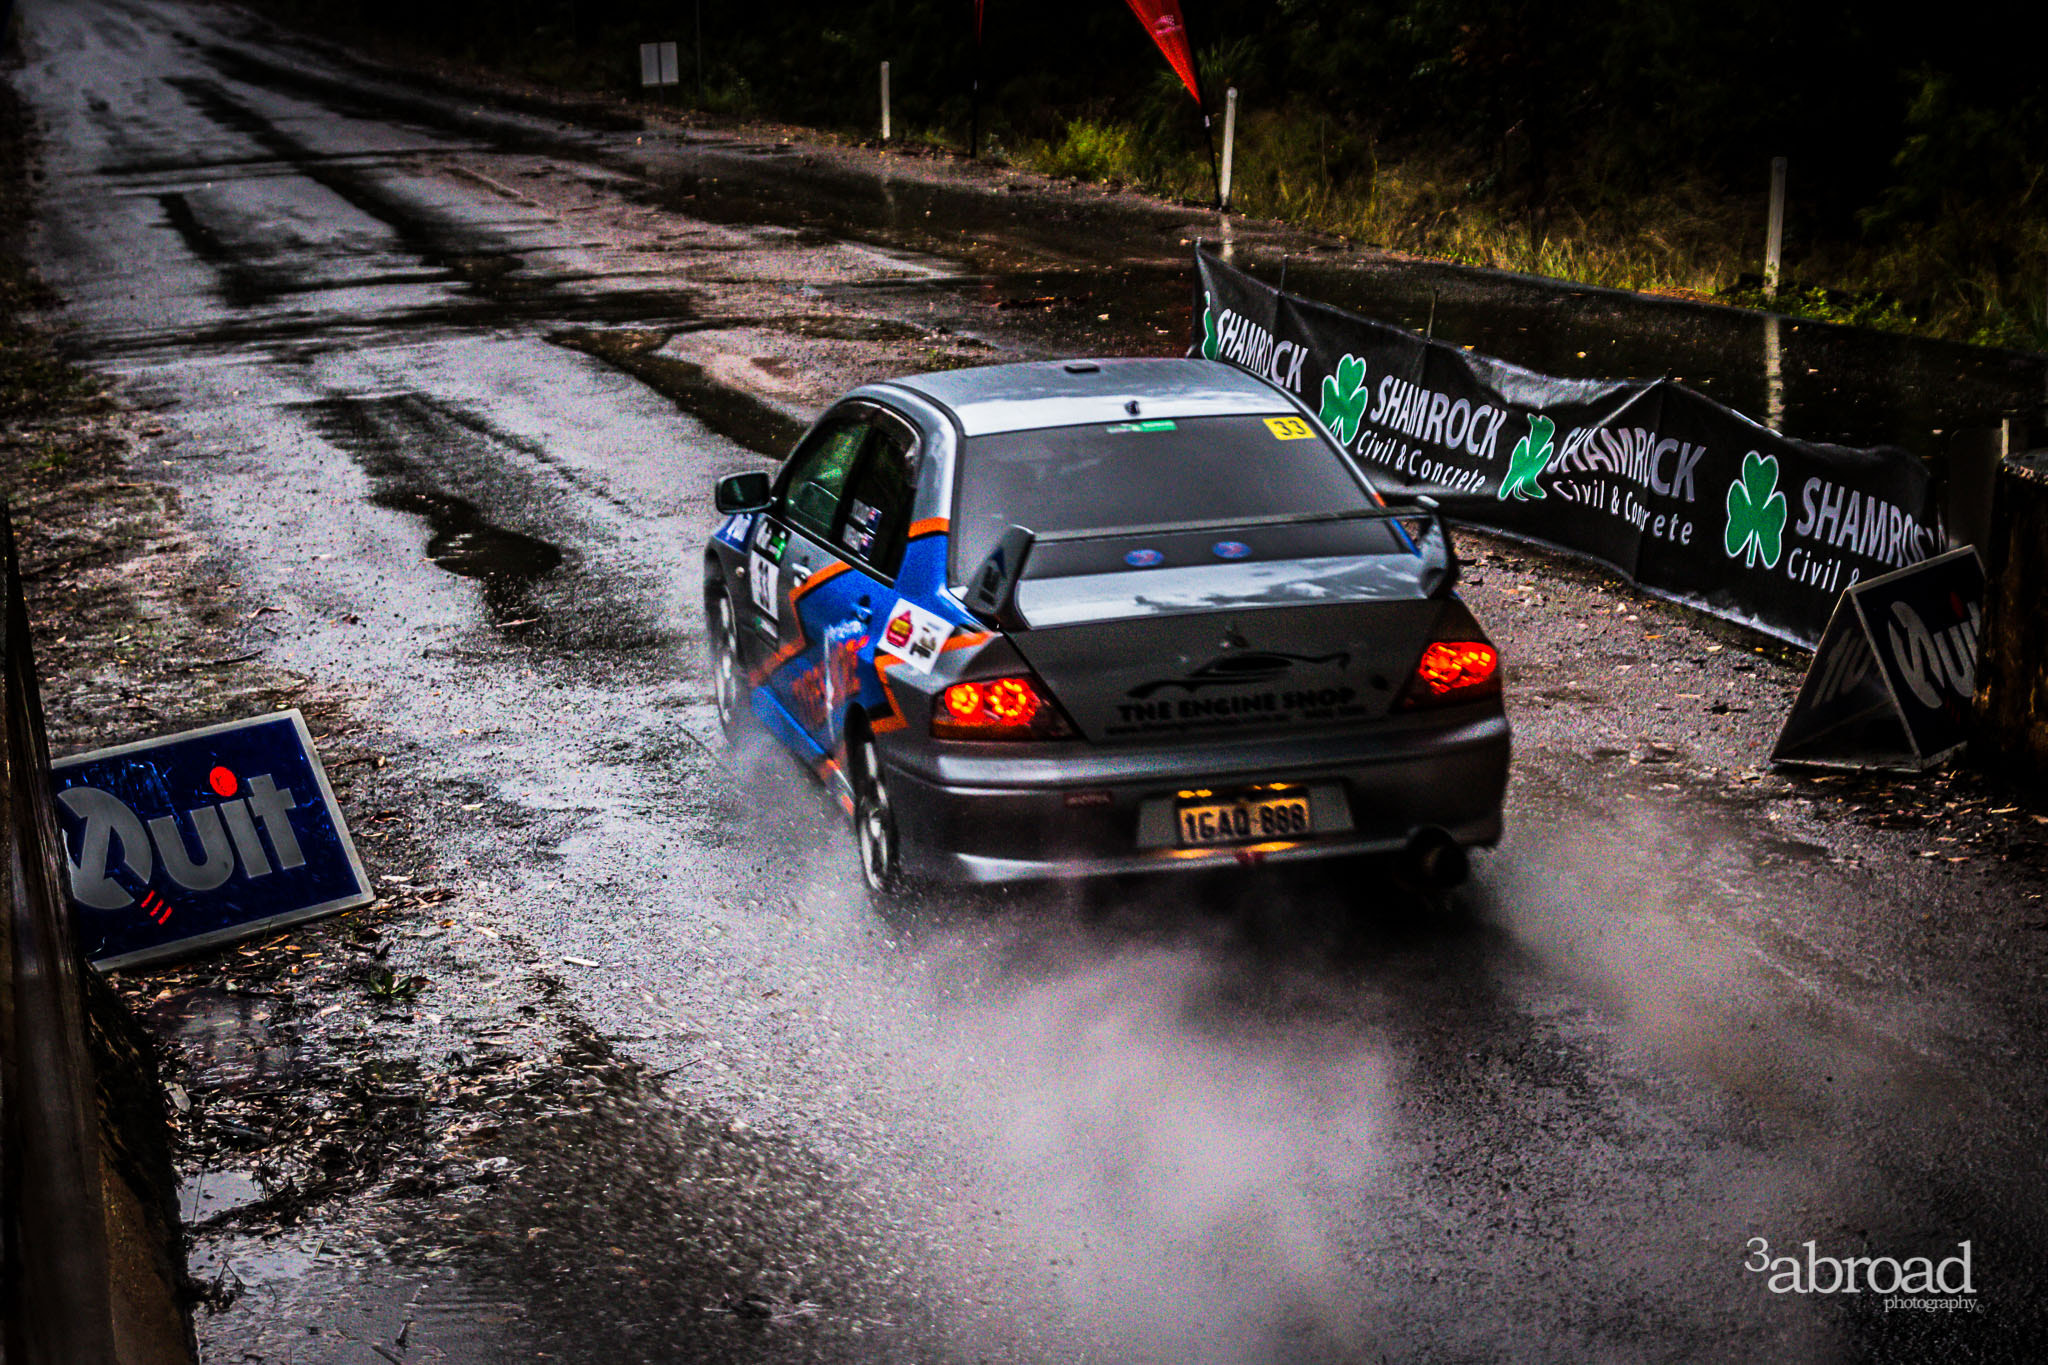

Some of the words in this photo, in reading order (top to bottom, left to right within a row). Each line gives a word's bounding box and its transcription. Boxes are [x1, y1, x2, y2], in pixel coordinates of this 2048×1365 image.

[1217, 308, 1309, 393] SHAMROCK
[1273, 420, 1307, 437] 33
[1369, 374, 1508, 461] SHAMROCK
[1356, 430, 1398, 465] Civil
[1395, 444, 1407, 471] &
[1408, 449, 1487, 494] Concrete
[1546, 426, 1707, 503] SHAMROCK
[1552, 479, 1605, 509] Civil
[1610, 485, 1620, 515] &
[1787, 547, 1841, 593] Civil
[1117, 702, 1171, 722] THE
[1177, 693, 1276, 718] ENGINE
[1281, 686, 1355, 710] SHOP
[57, 765, 307, 910] Quit
